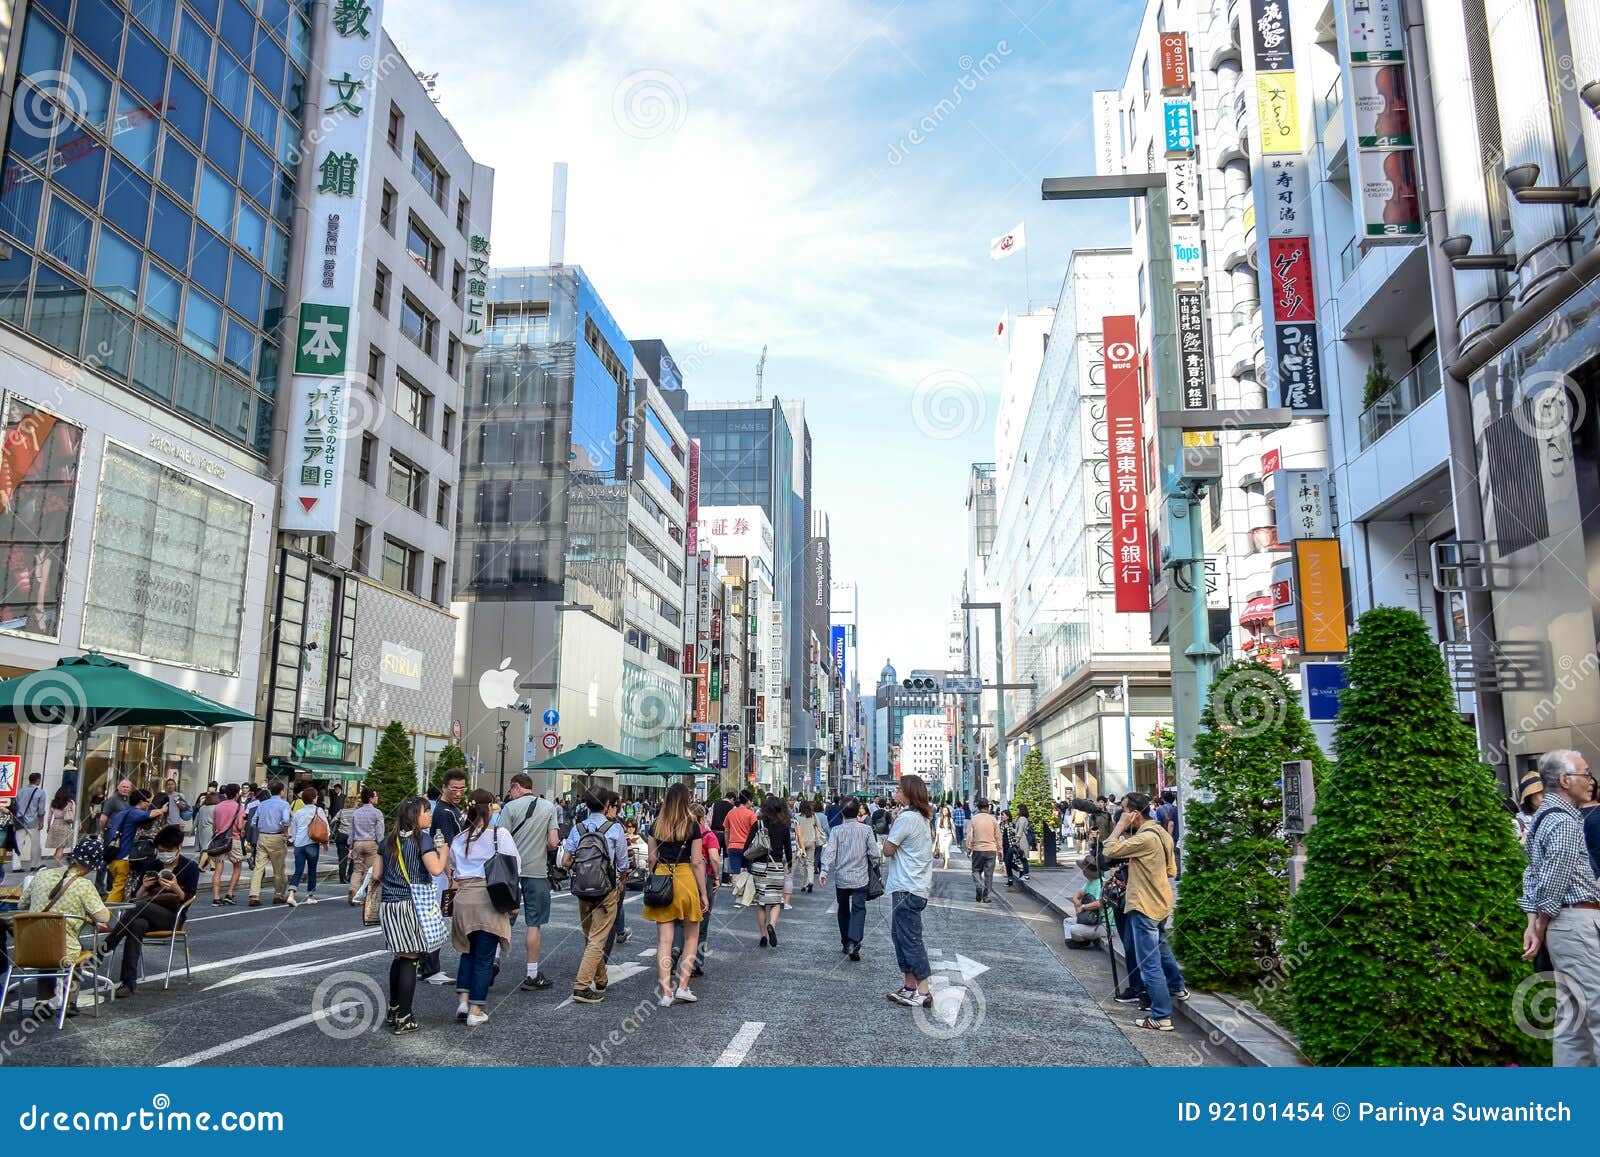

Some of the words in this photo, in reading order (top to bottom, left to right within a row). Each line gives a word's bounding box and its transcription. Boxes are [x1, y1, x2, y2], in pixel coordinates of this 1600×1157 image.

[1165, 38, 1184, 82] genten
[1367, 52, 1389, 60] 5F
[1168, 110, 1178, 148] イーオン
[1374, 137, 1398, 146] 4F
[1173, 163, 1189, 211] ざくろ
[325, 213, 340, 256] SINCE
[1384, 225, 1407, 234] 3F
[466, 235, 491, 335] 教文館ビル
[302, 316, 344, 364] 本
[300, 388, 328, 485] ナルニア国
[728, 423, 767, 431] CHANEL
[323, 468, 334, 489] 6F
[1115, 416, 1142, 584] 三菱東京UFJ銀行
[696, 517, 751, 536] 証券
[384, 652, 420, 680] FURLA
[546, 737, 556, 746] 50
